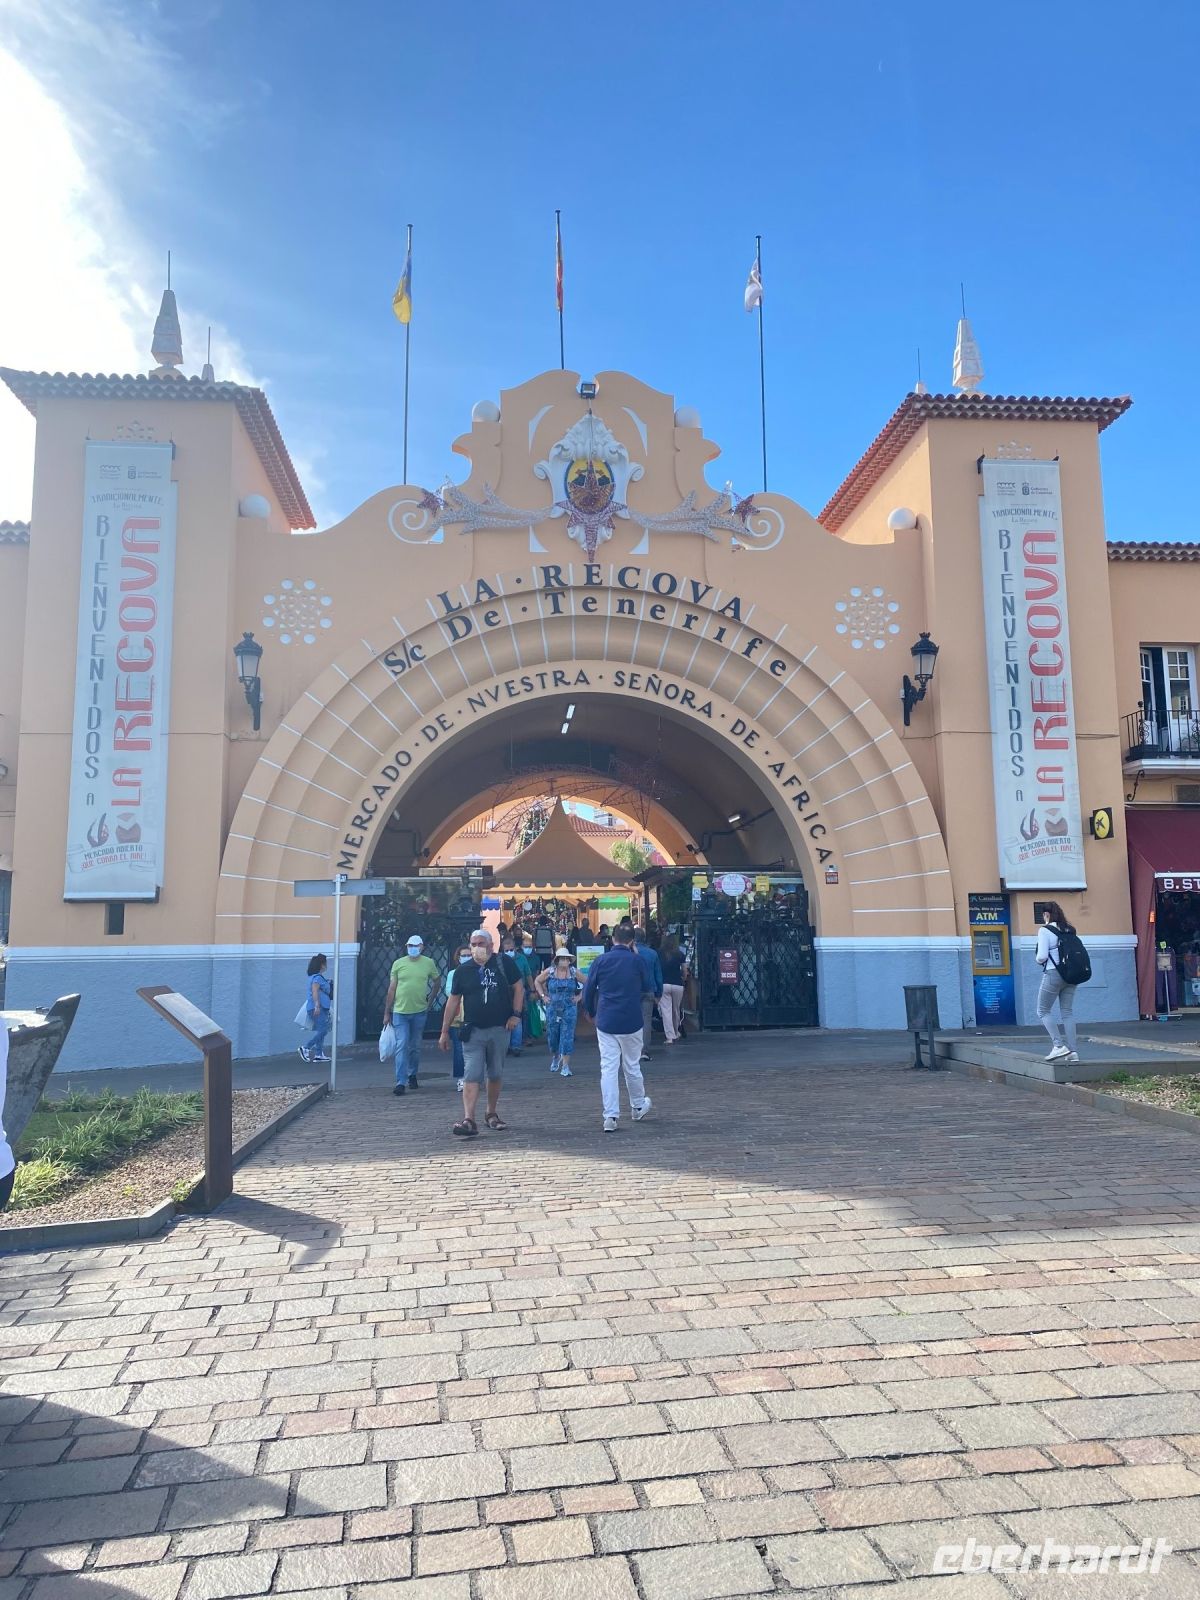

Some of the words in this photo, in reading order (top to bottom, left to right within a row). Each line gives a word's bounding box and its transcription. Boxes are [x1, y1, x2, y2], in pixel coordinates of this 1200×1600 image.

[84, 515, 110, 779] BIENVENIDOS
[113, 516, 161, 752] RECOVA
[384, 642, 426, 677] S/c
[443, 610, 501, 642] De
[544, 591, 787, 677] Tenerife
[437, 578, 499, 615] LA
[540, 563, 742, 621] RECOVA
[998, 529, 1025, 778] BIENVENIDOS
[1023, 530, 1069, 750] RECOVA
[111, 767, 142, 807] LA
[337, 750, 412, 870] MERCADO
[421, 713, 454, 743] DE
[467, 668, 590, 713] NVESTRA
[614, 670, 713, 718] SEÑORA
[730, 718, 760, 749] DE
[768, 762, 833, 864] AFRICA
[1036, 766, 1065, 802] LA
[976, 912, 998, 920] ATM
